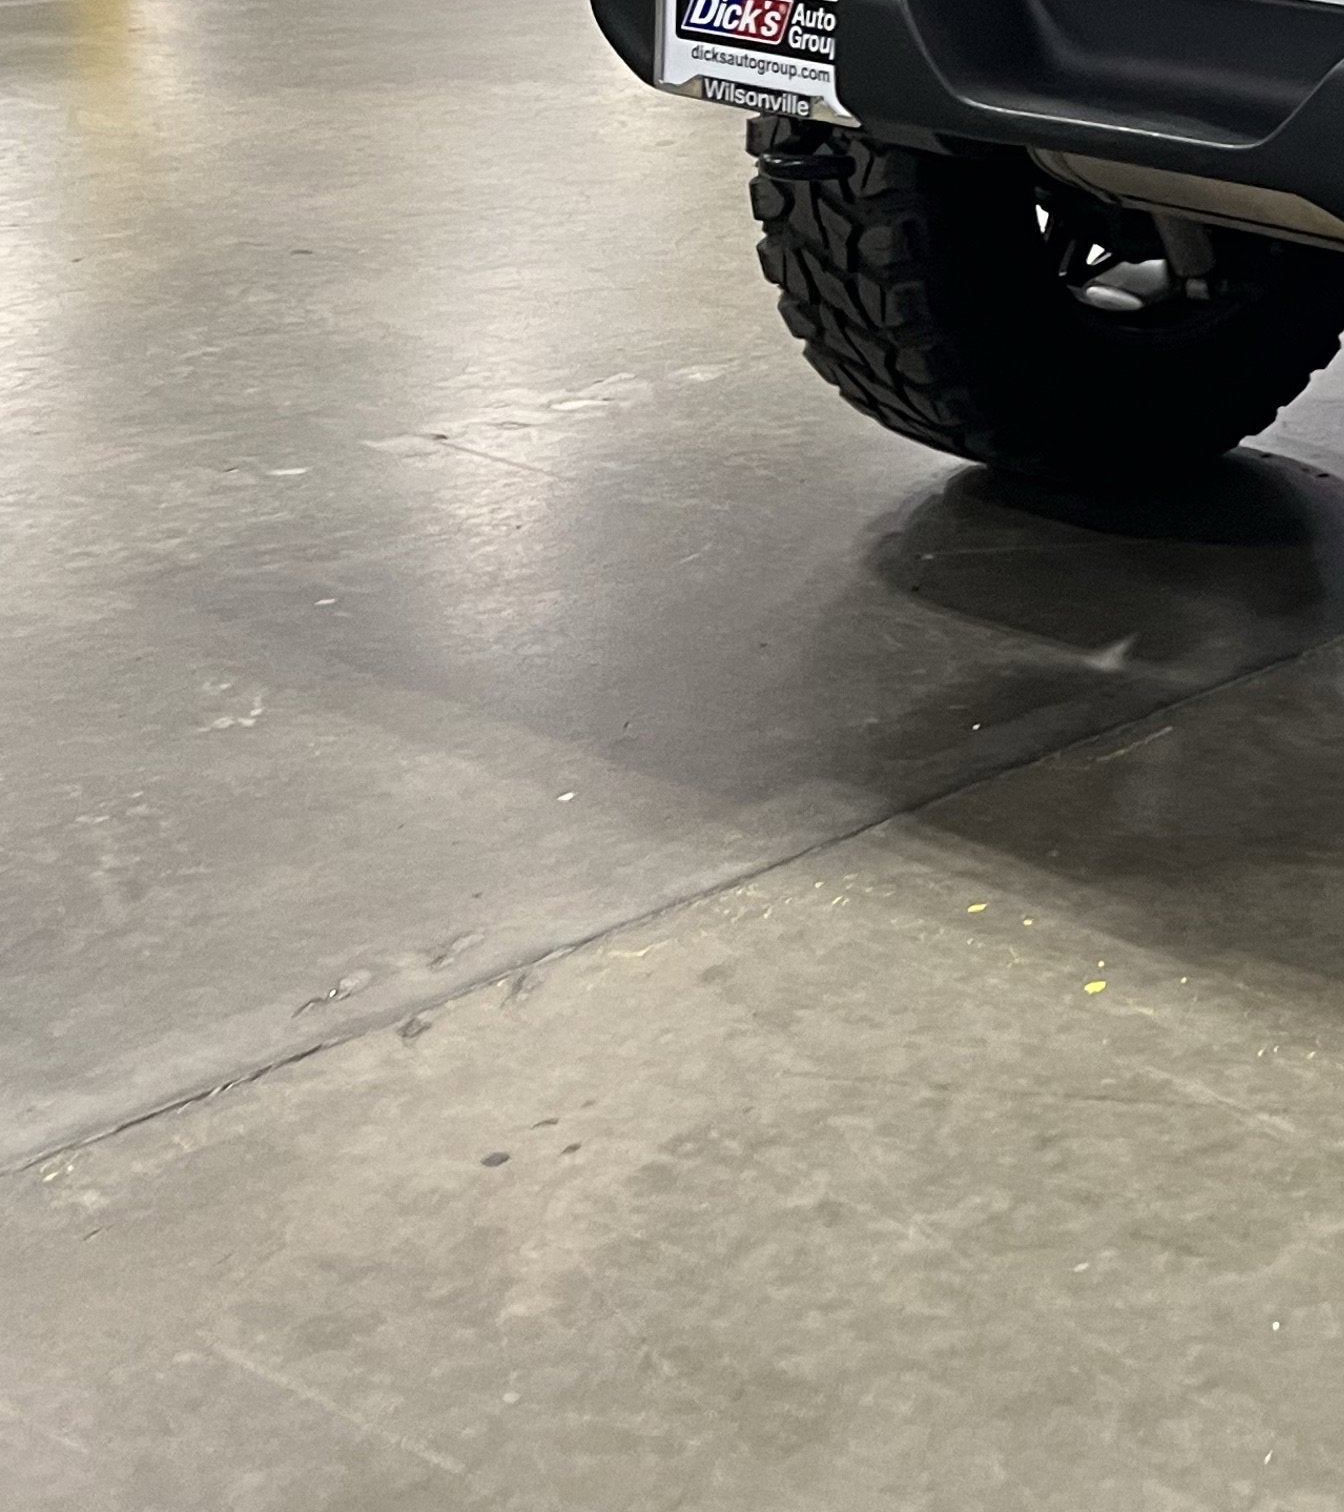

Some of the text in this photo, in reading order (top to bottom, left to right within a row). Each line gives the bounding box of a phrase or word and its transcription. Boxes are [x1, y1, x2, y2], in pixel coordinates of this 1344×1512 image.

[791, 2, 837, 32] Auto
[691, 44, 831, 83] dicksautogroup.com
[704, 77, 810, 117] Wilsonville
